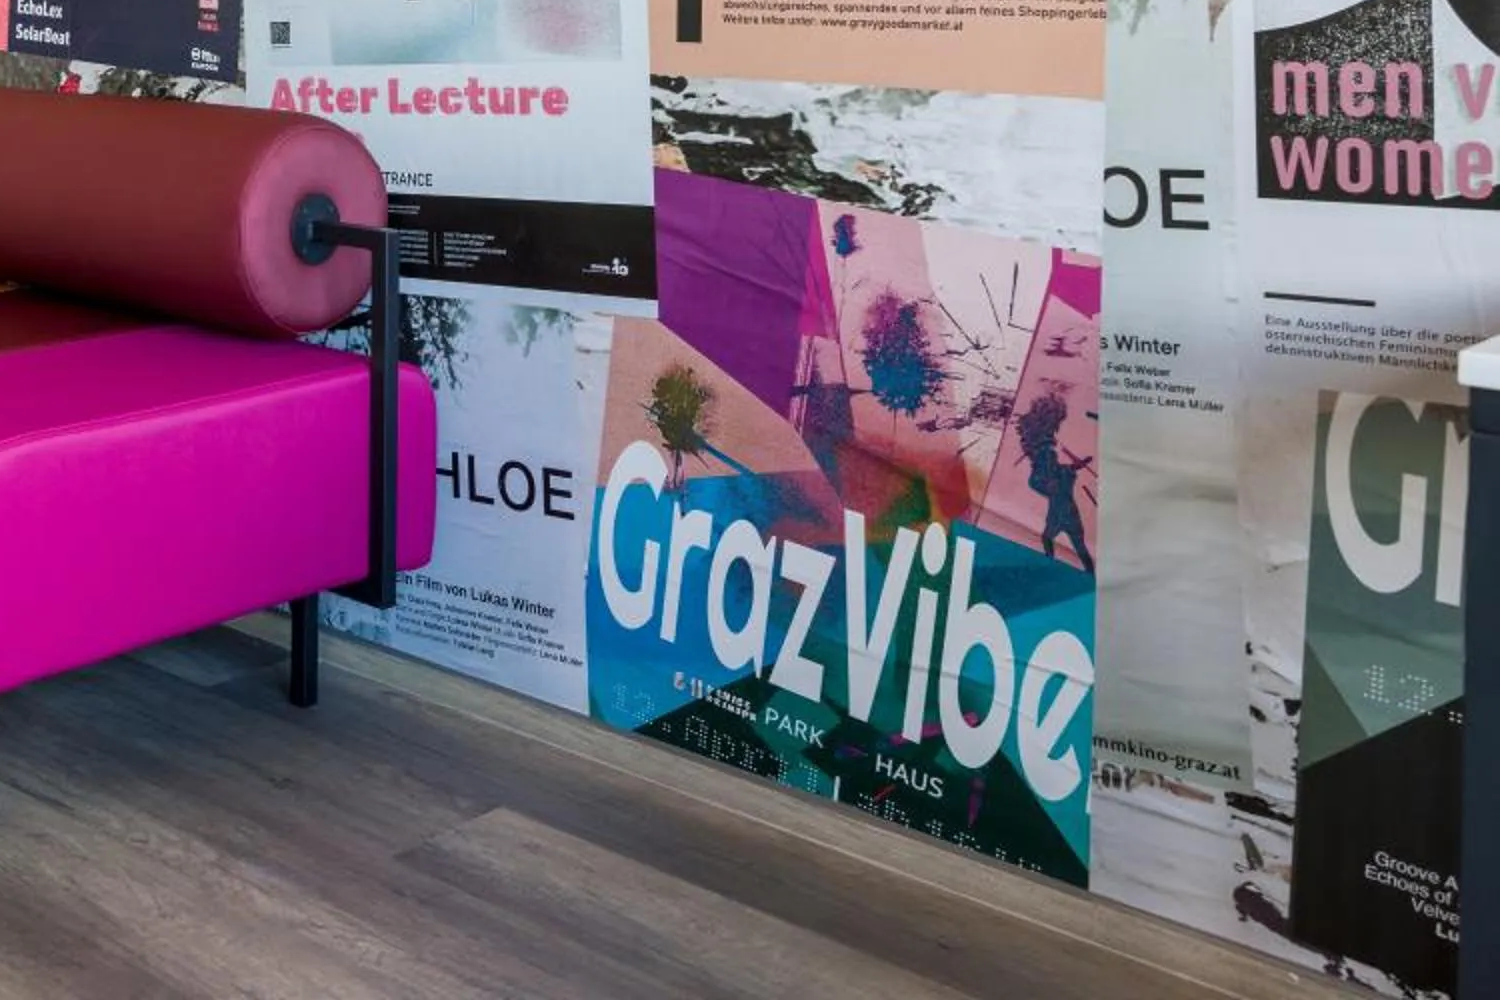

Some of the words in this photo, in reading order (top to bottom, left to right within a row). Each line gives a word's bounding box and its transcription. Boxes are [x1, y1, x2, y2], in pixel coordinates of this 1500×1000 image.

[17, 1, 63, 20] EchoLex
[15, 25, 71, 47] SolarBeat
[271, 76, 379, 117] After
[388, 77, 569, 116] Lecture
[1272, 58, 1424, 119] men
[1270, 135, 1495, 201] wome
[1115, 334, 1181, 358] Winter
[1265, 330, 1375, 350] österreichischen
[1296, 316, 1376, 338] Ausstellung
[1381, 325, 1412, 339] über
[1417, 328, 1439, 341] die
[415, 574, 443, 592] Film
[445, 583, 467, 599] von
[471, 587, 509, 609] Lukas
[511, 595, 556, 619] Winter
[764, 706, 828, 749] PARK
[874, 753, 945, 799] HAUS
[1363, 863, 1431, 900] Echoes
[1433, 886, 1452, 906] of
[1374, 850, 1441, 886] Groove
